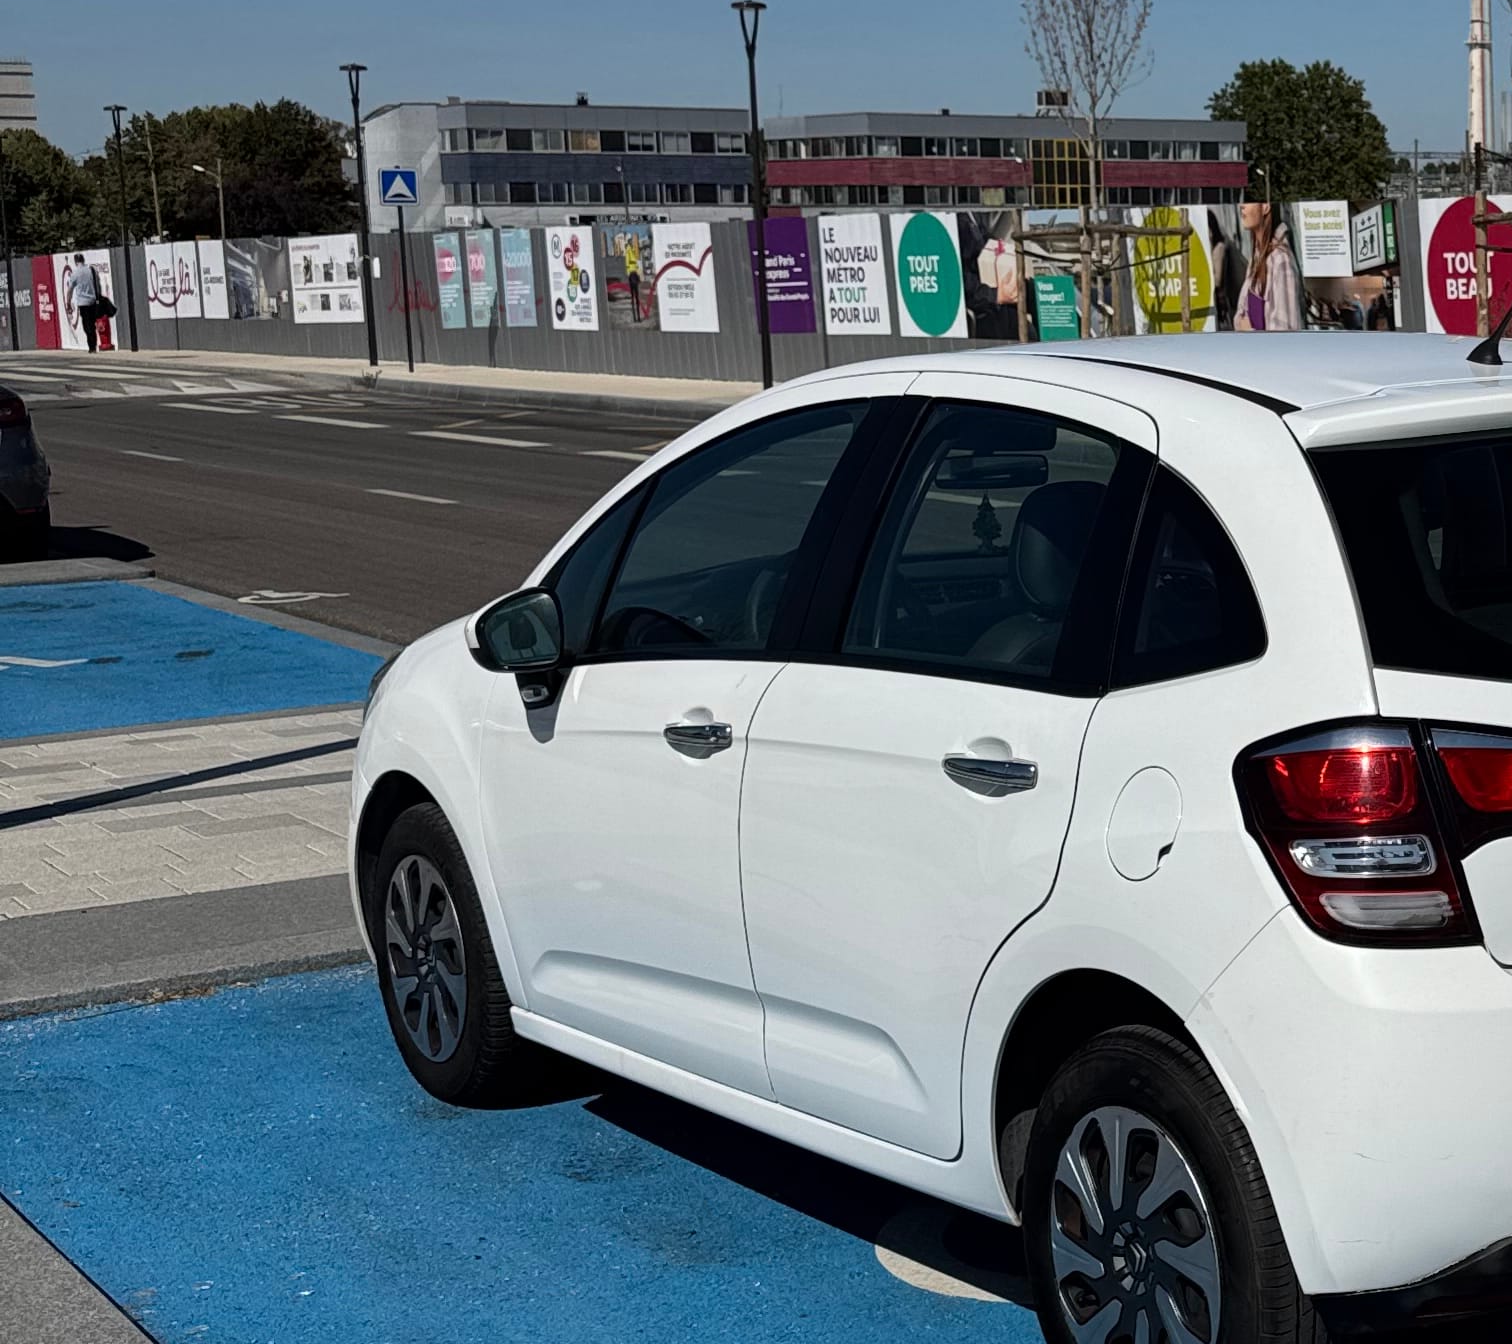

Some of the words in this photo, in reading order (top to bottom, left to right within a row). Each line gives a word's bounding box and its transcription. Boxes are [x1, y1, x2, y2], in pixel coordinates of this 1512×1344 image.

[822, 228, 836, 244] LE
[824, 246, 879, 264] NOUVEAU
[907, 255, 940, 272] TOUT
[827, 264, 866, 284] MÉTRO
[909, 272, 939, 294] PRÈS
[1148, 277, 1199, 298] SIMPE
[828, 288, 837, 304] A
[837, 287, 868, 304] TOUT
[830, 307, 862, 324] POUR
[863, 307, 881, 324] LUI
